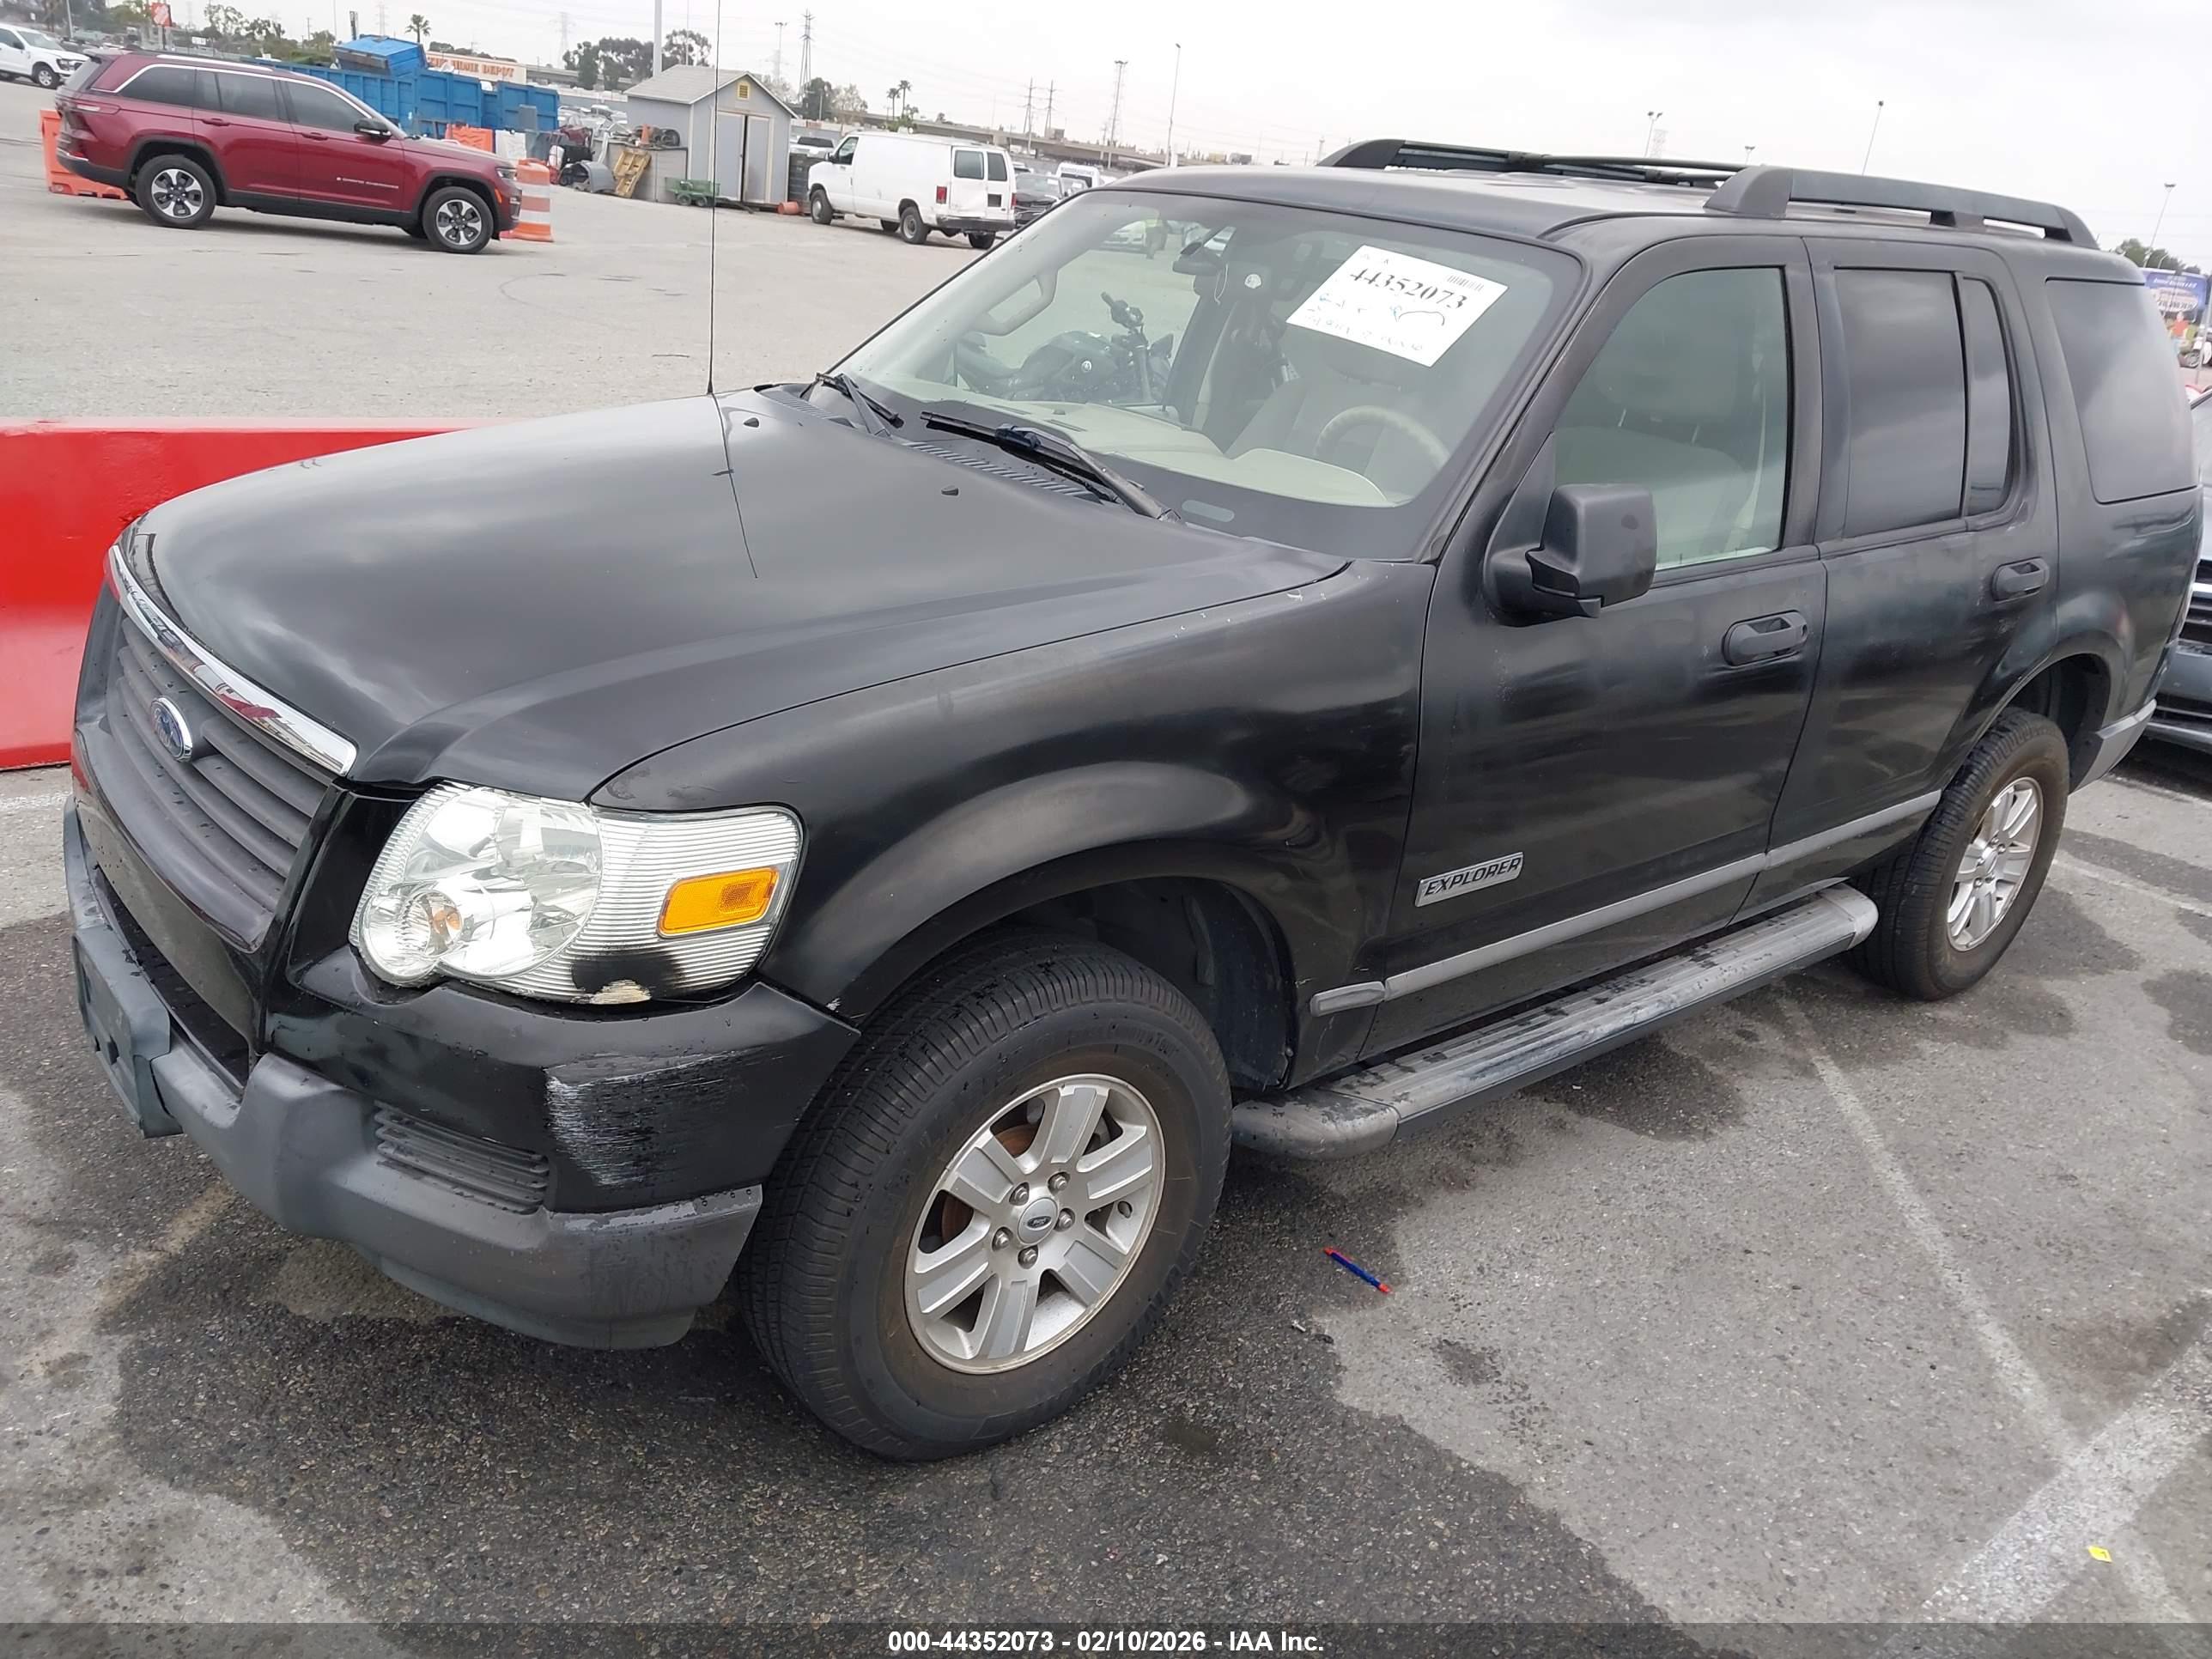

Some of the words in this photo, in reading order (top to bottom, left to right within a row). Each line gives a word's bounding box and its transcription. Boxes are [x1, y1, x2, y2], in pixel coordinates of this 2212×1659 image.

[483, 64, 514, 77] DEPOT
[1350, 268, 1468, 308] 44352073
[1425, 857, 1522, 896] EXPLORER
